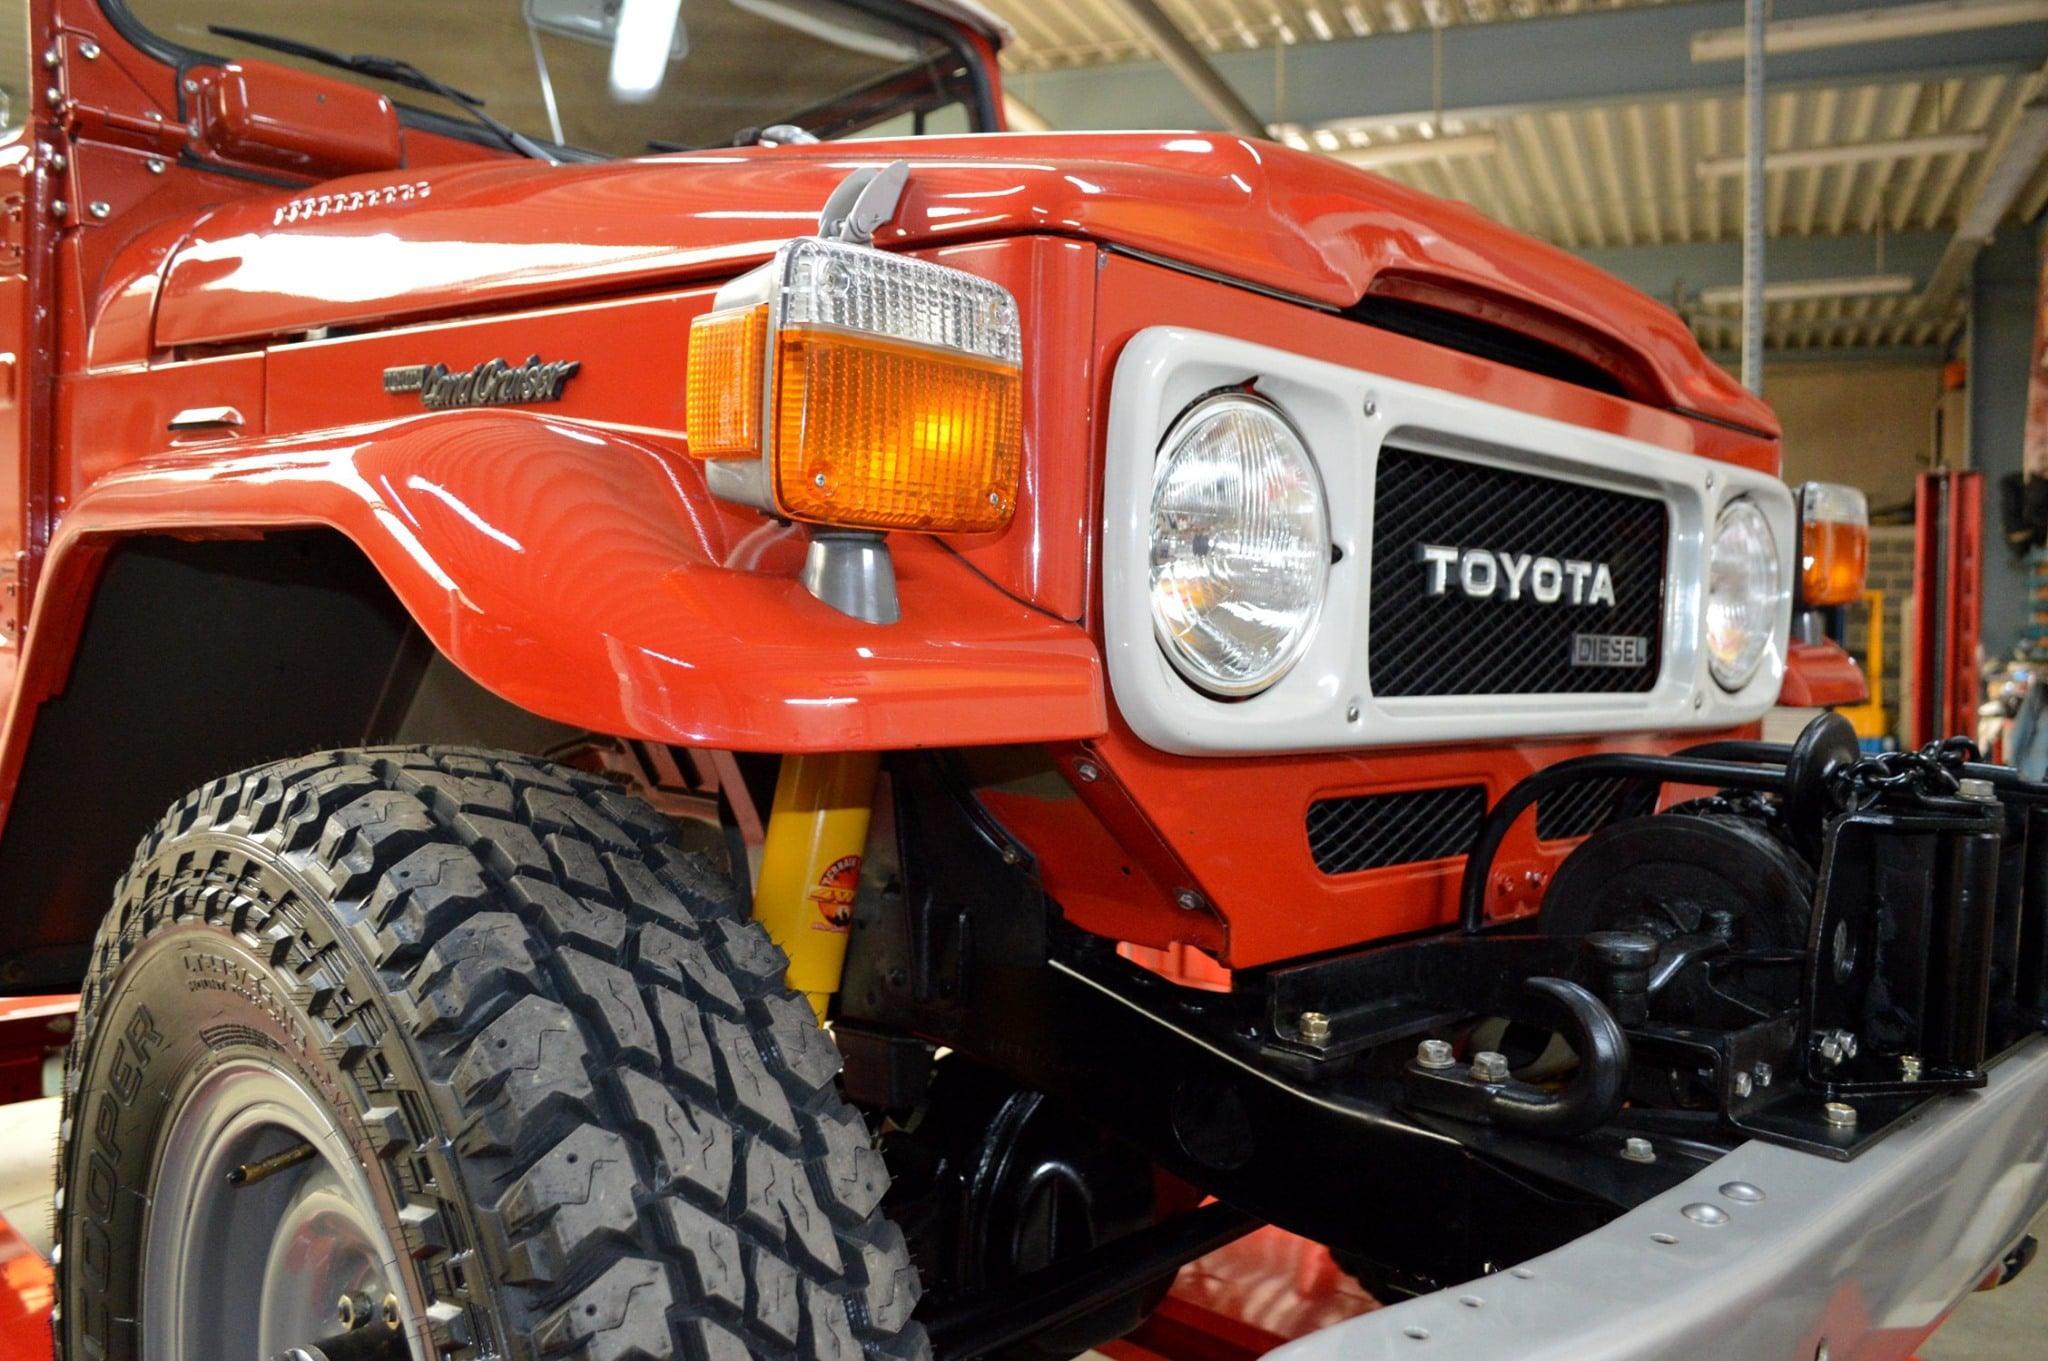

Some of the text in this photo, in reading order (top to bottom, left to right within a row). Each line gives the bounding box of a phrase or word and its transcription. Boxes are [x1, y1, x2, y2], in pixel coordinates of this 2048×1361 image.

[421, 363, 480, 409] Land
[474, 354, 580, 404] Cruiser
[1421, 545, 1616, 607] TOYOTA
[1577, 637, 1645, 664] DIESEL
[81, 1001, 165, 1361] COOPER
